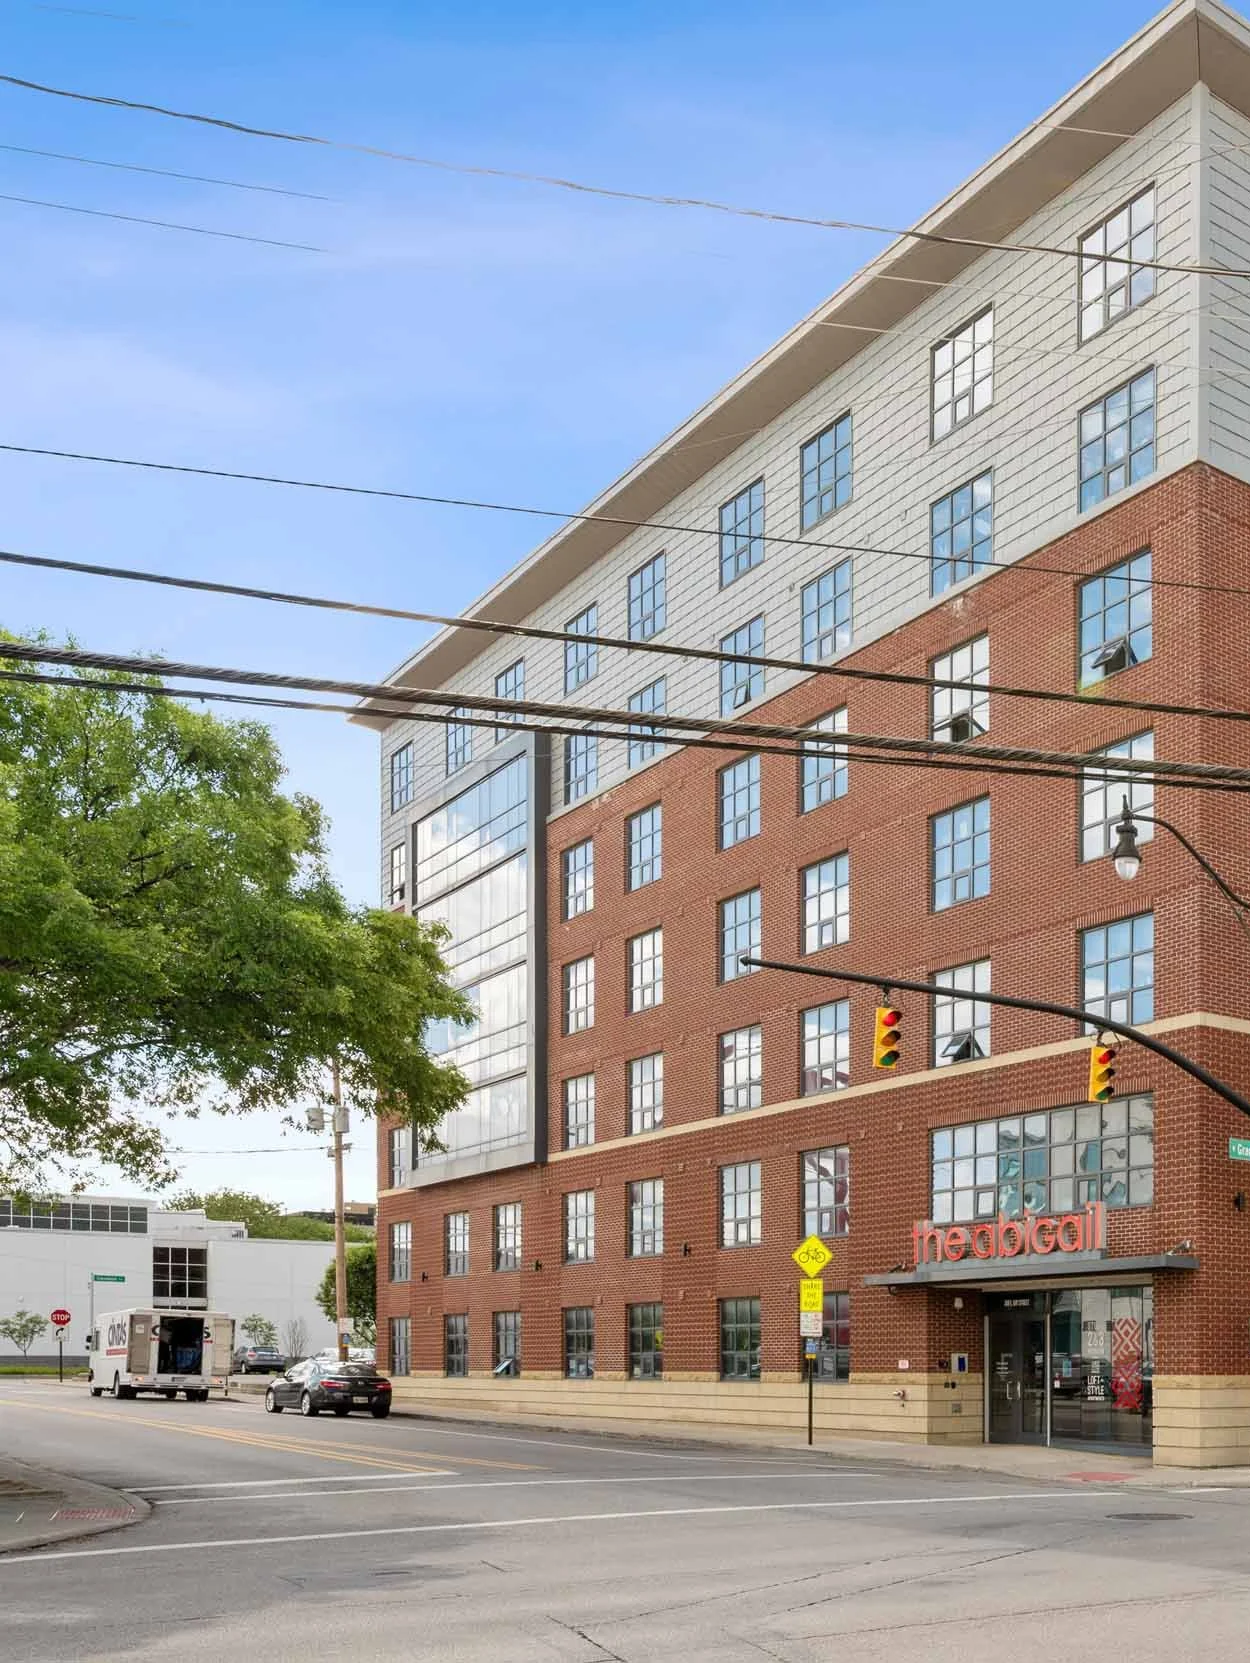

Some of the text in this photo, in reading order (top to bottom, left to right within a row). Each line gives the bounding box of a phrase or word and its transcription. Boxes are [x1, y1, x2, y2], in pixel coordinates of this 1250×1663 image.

[912, 1201, 1107, 1264] the abigail
[52, 1313, 70, 1321] STOP
[1087, 1385, 1105, 1395] STYLE
